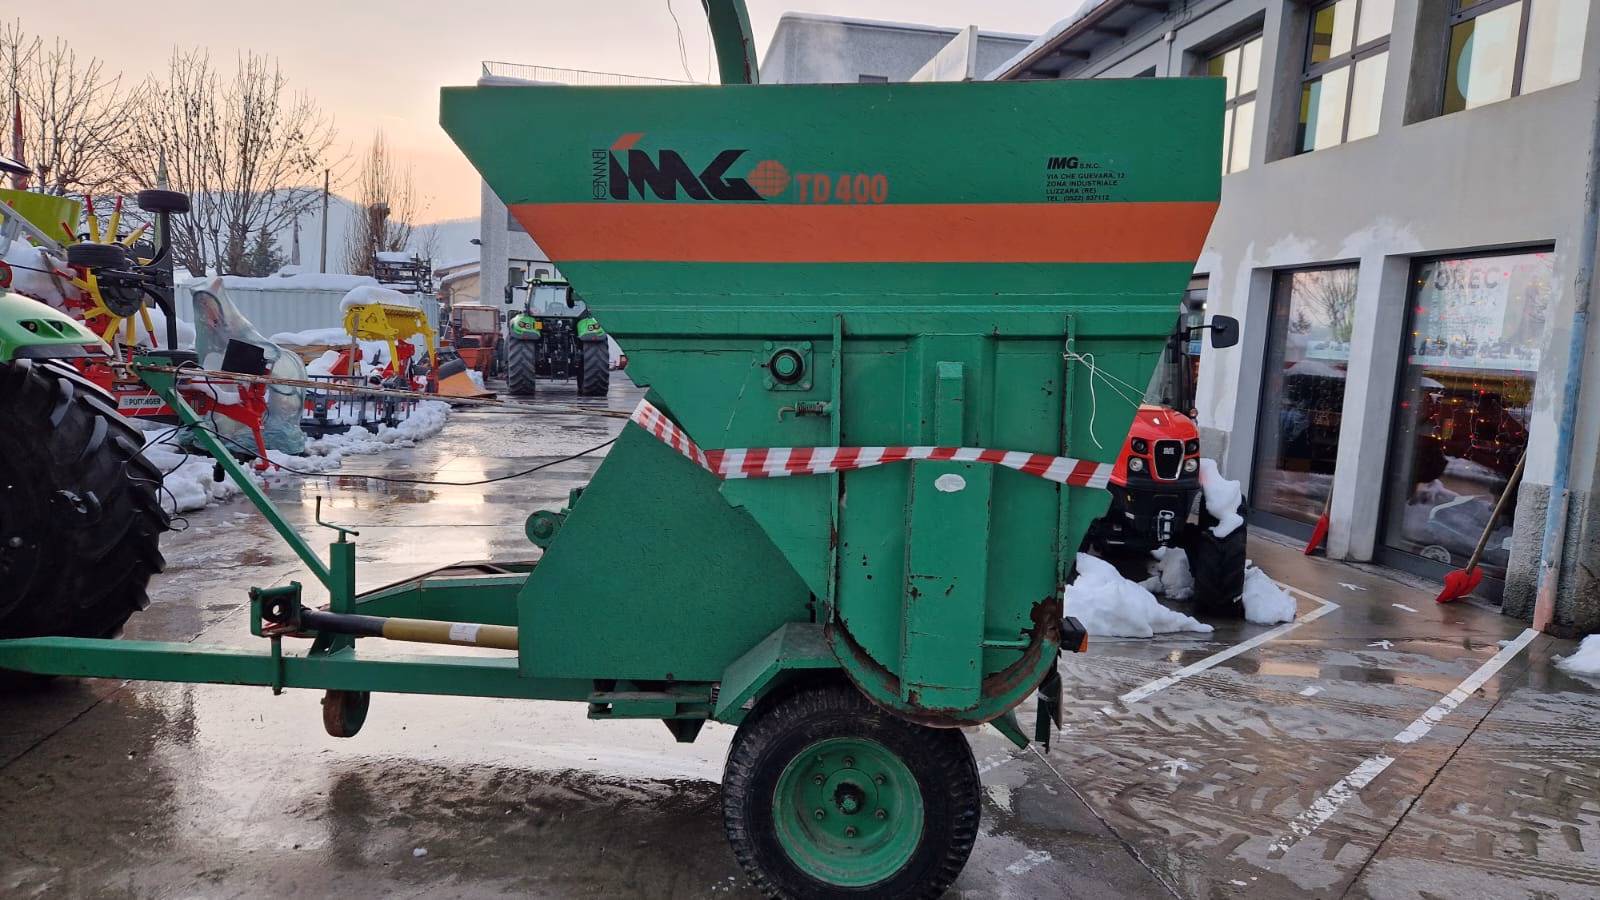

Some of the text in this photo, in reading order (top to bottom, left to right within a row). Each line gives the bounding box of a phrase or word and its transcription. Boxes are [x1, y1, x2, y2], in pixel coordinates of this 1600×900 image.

[1047, 157, 1078, 170] IMG
[795, 173, 888, 203] TD 400
[1068, 179, 1118, 187] INDUSTRIALE
